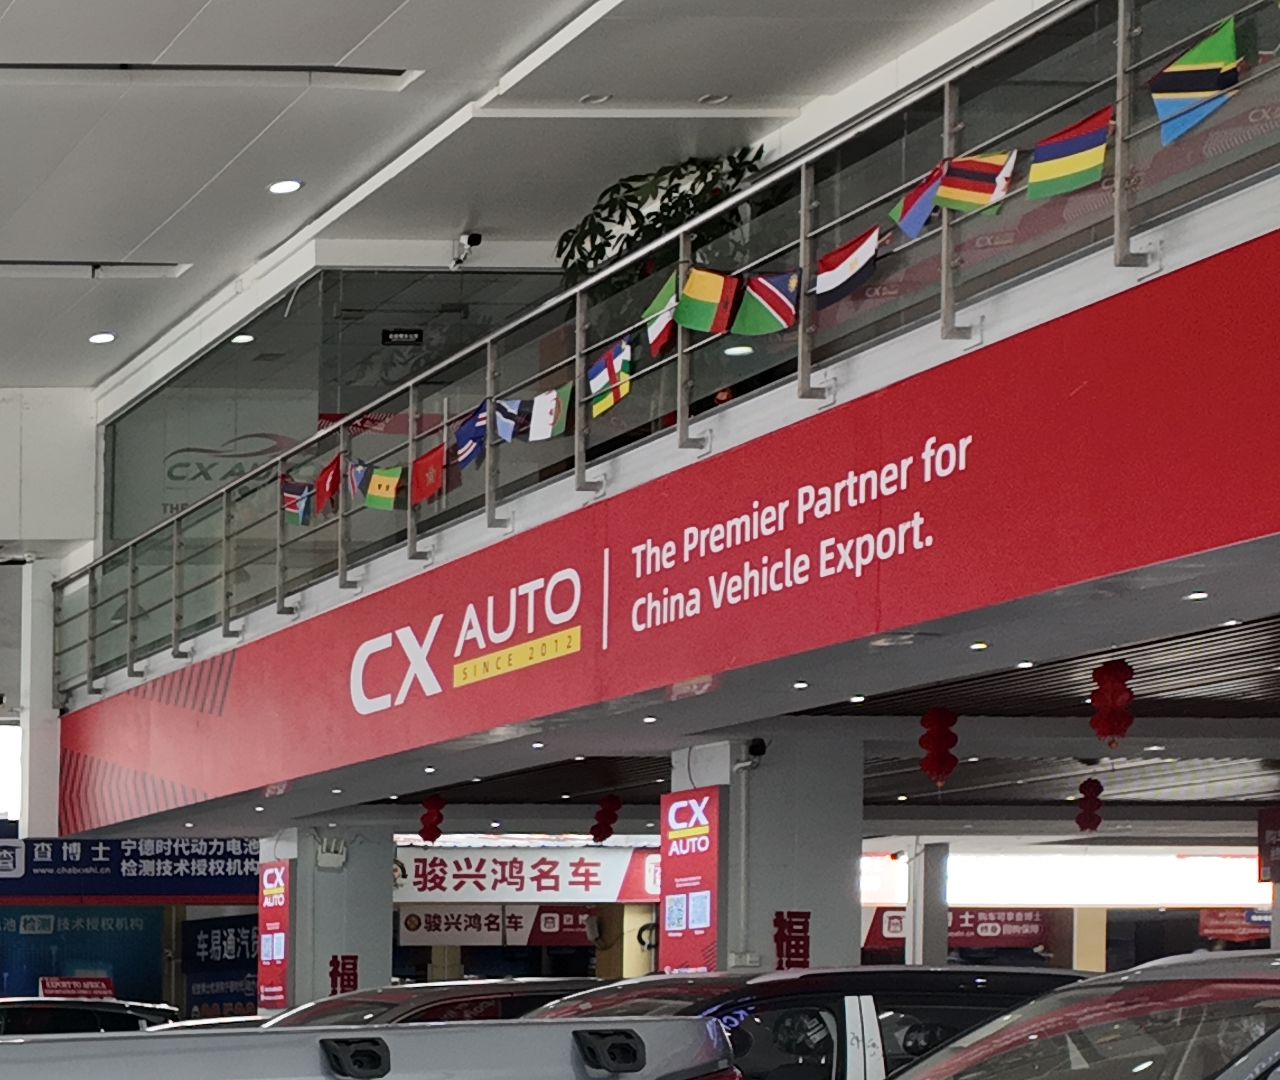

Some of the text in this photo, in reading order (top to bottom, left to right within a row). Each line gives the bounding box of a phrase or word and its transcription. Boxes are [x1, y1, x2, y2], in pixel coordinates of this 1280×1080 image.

[167, 462, 219, 481] CX
[631, 435, 973, 579] The Premier Partner for
[631, 511, 934, 632] China Vehicle Export.
[350, 568, 581, 715] CX AUTO
[462, 634, 574, 681] SINCE 2012
[668, 797, 709, 829] CX
[33, 842, 111, 862] 查博士
[120, 838, 260, 857] 宁德时代动力电池
[668, 836, 709, 857] AUTO
[120, 859, 260, 877] 检测技术授权机构
[263, 866, 285, 889] CX
[413, 857, 602, 893] 骏兴鸿名车
[263, 894, 285, 907] AUTO
[424, 913, 524, 932] 骏兴鸿名车
